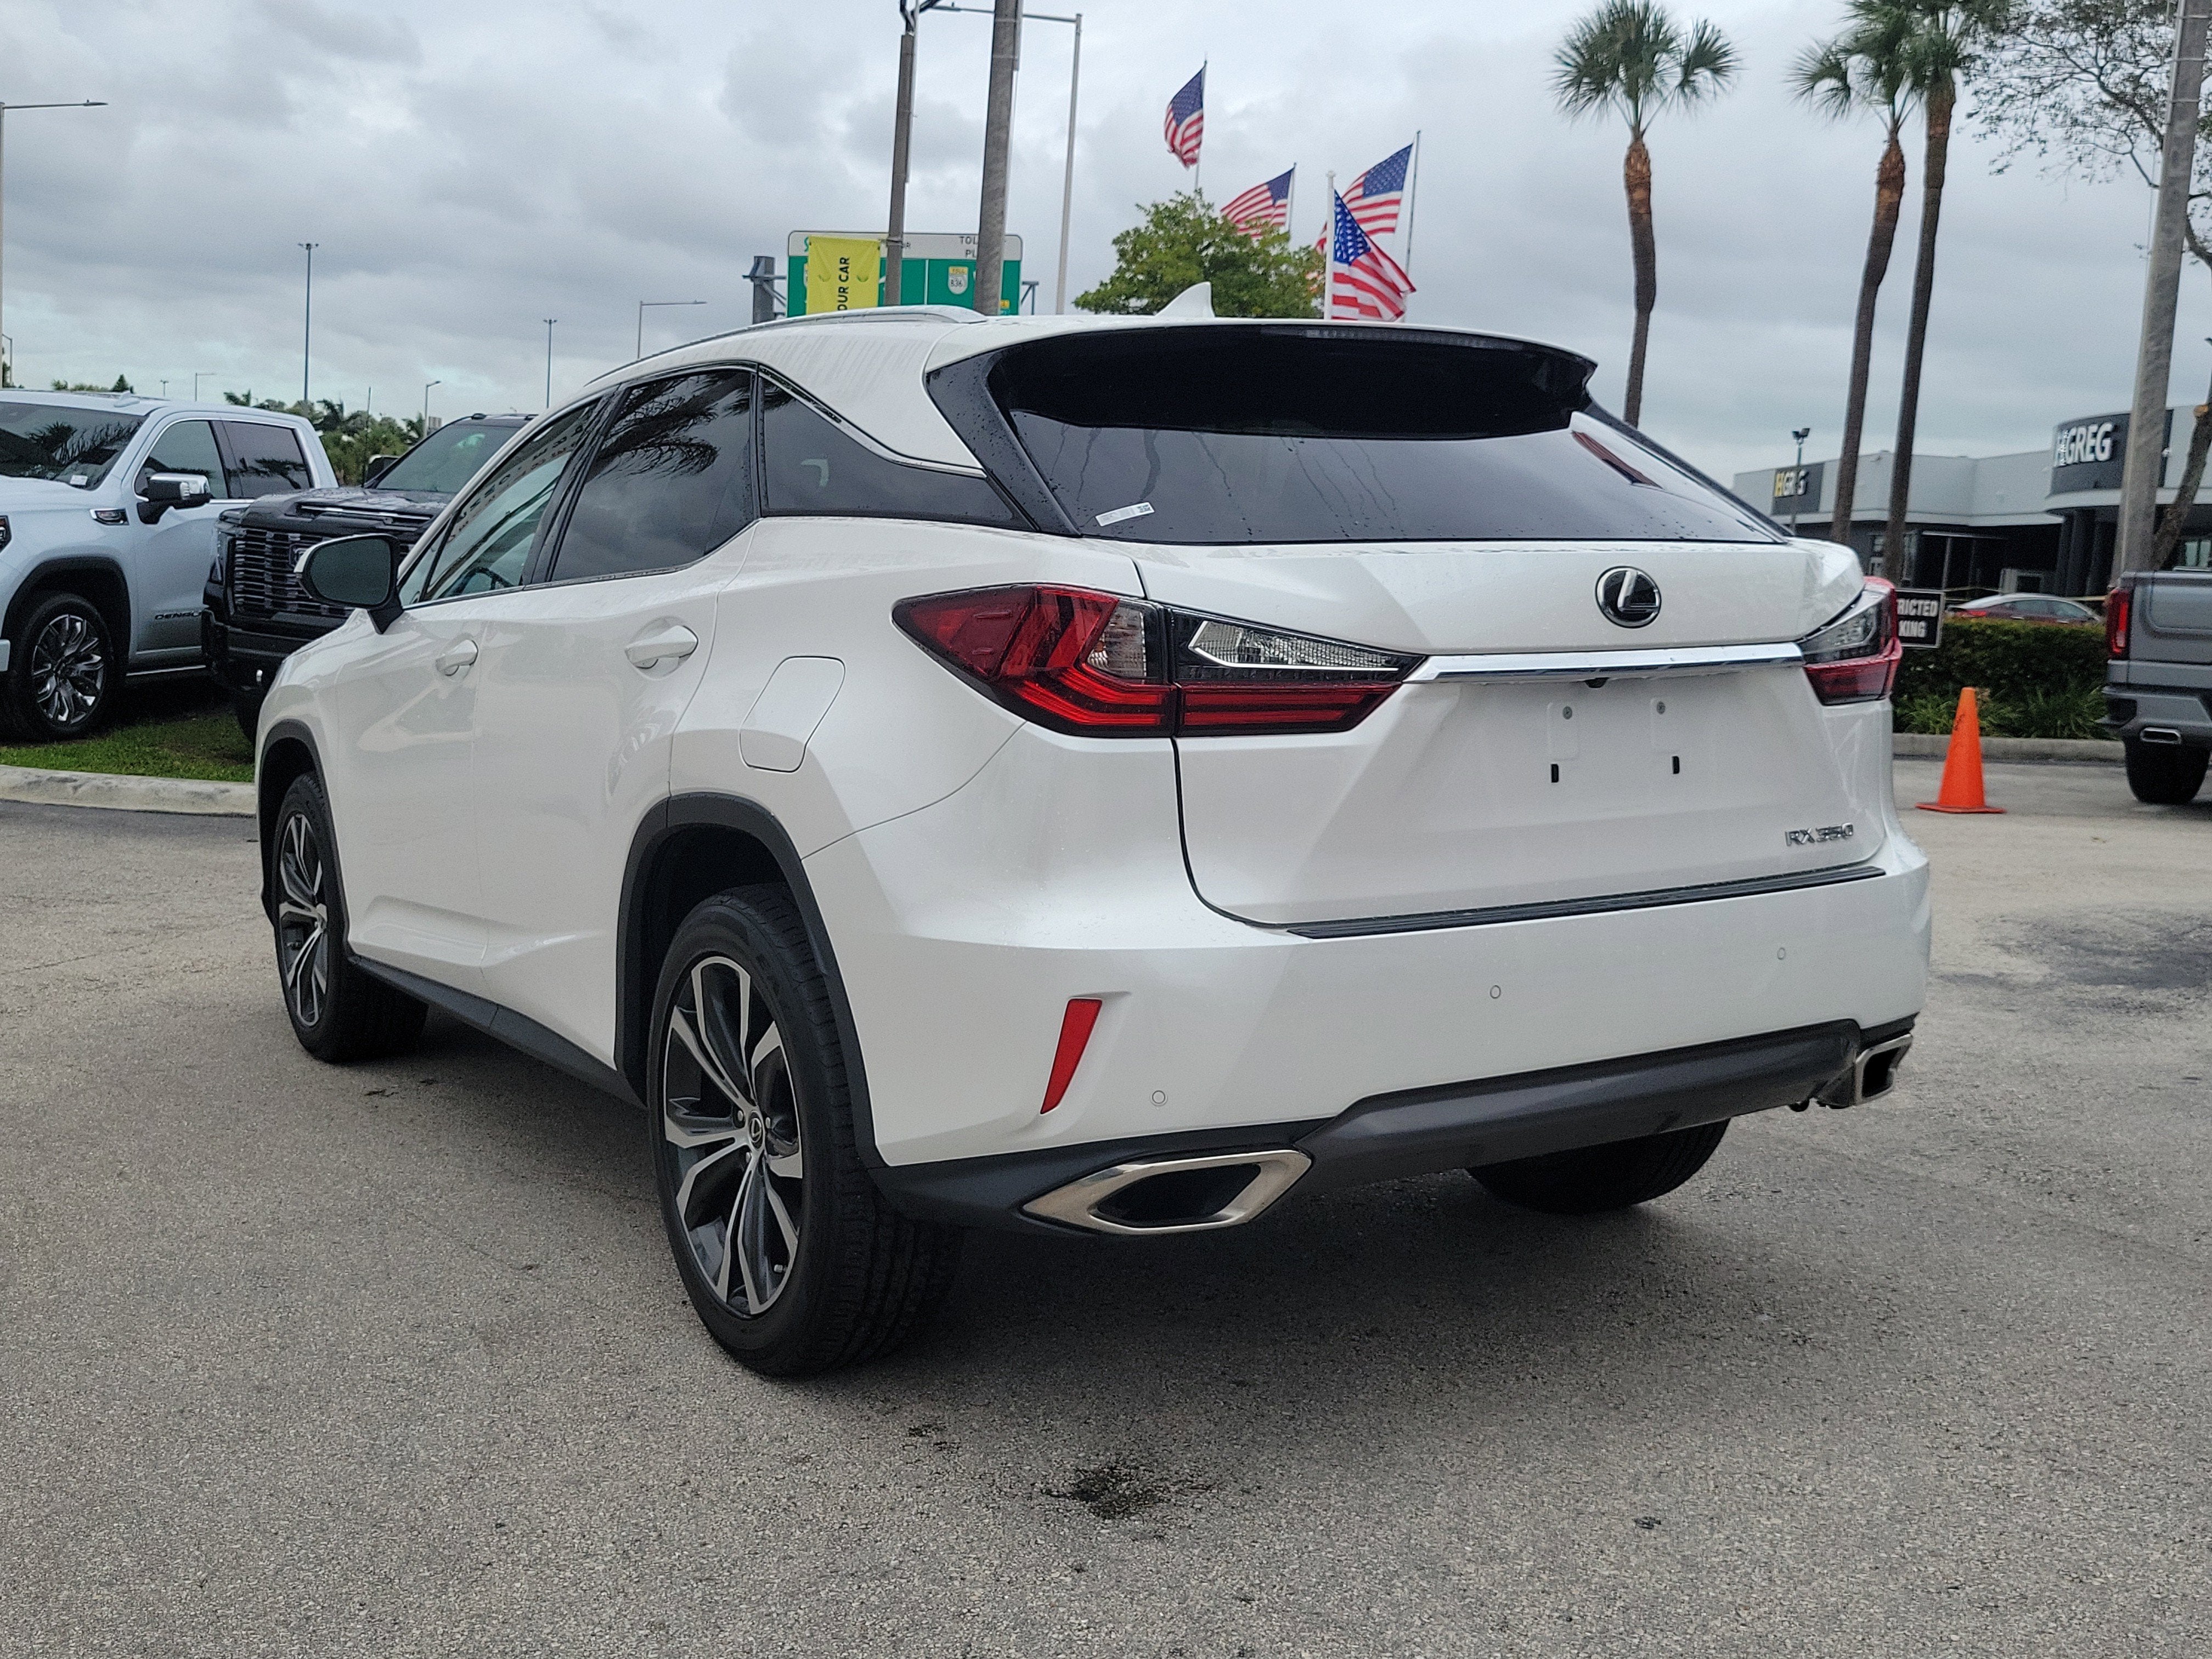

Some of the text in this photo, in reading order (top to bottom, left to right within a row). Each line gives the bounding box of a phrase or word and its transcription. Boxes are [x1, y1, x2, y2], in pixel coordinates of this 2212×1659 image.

[838, 257, 850, 283] CAR
[1774, 469, 1806, 497] HGRG
[1785, 828, 1815, 847] RX
